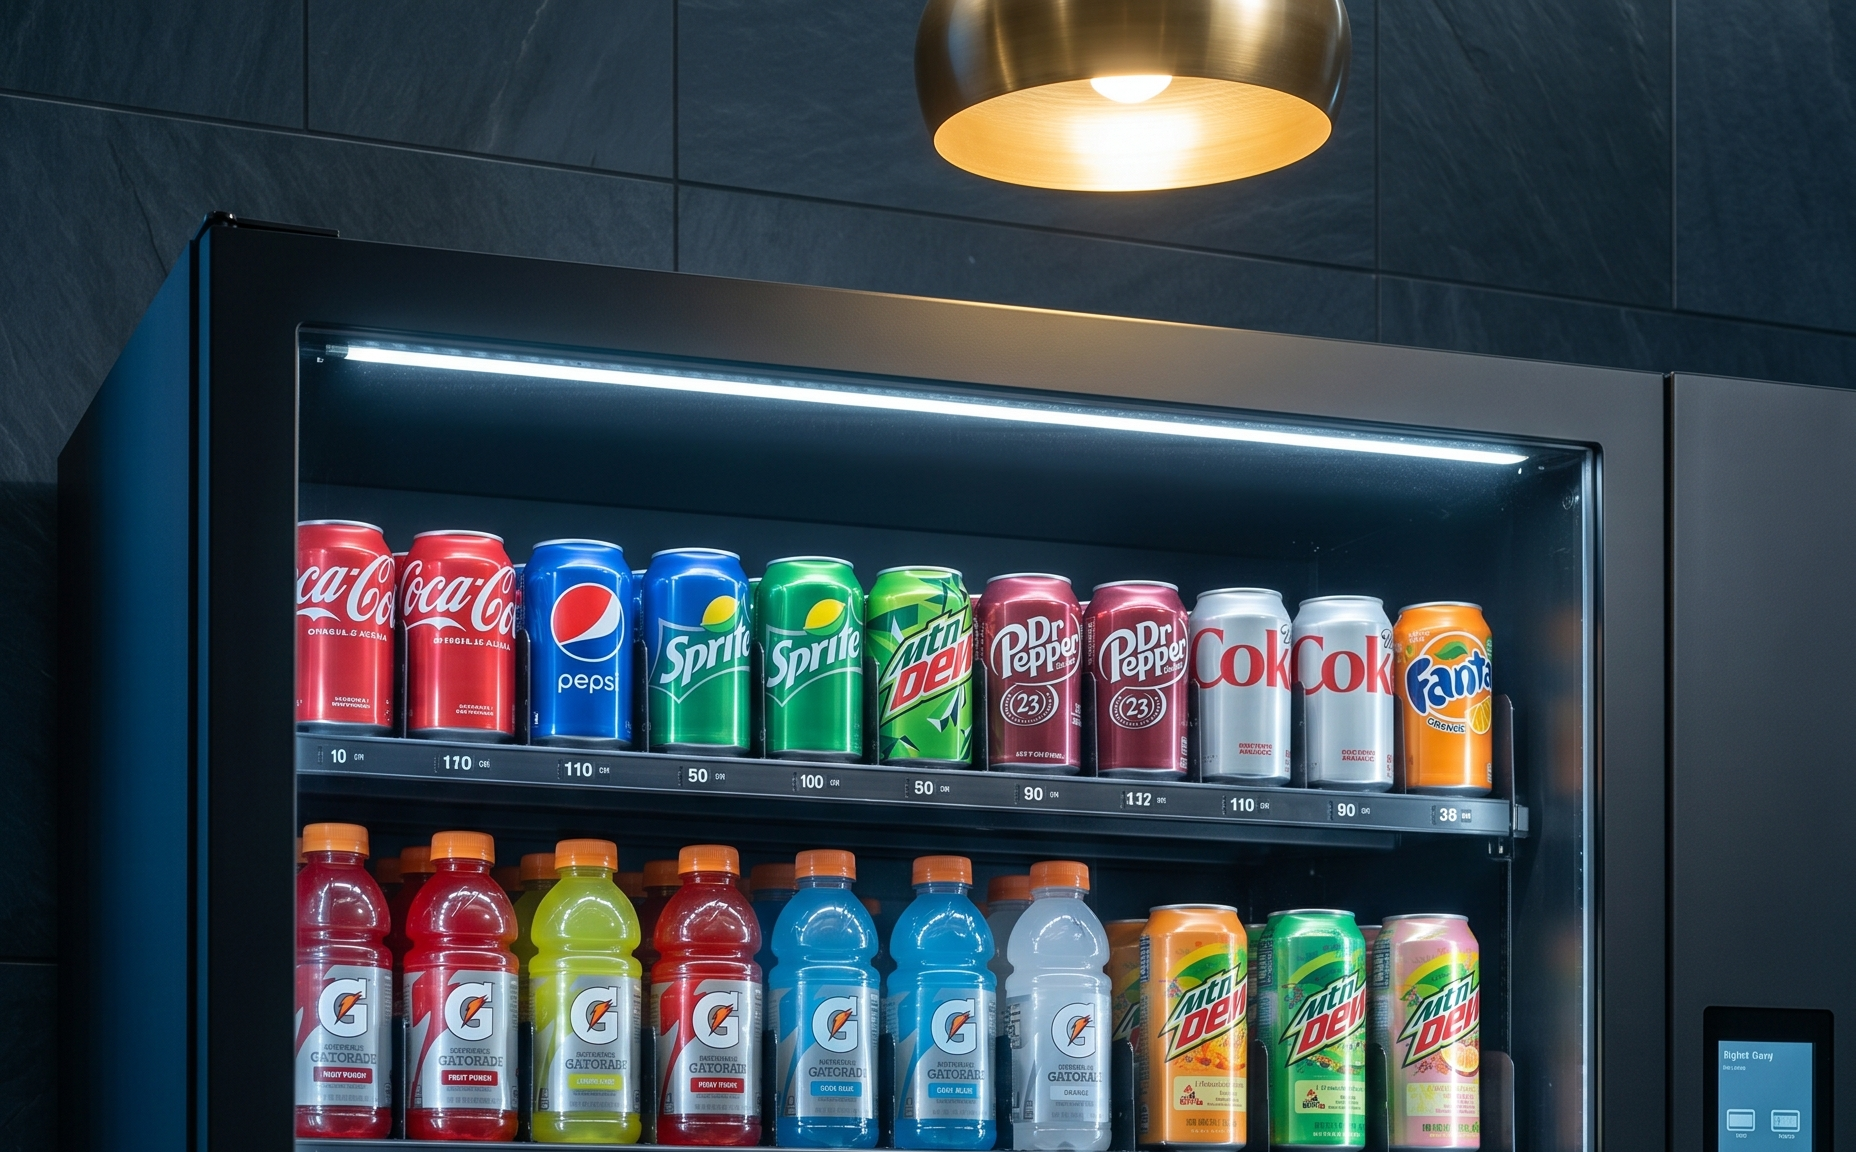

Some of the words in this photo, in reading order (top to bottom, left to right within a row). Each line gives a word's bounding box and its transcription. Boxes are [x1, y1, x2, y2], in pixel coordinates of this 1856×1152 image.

[660, 614, 750, 687] Sprite
[766, 618, 860, 690] Sprite
[889, 618, 961, 677] Mtn
[1000, 624, 1079, 680] Pepper
[1027, 616, 1064, 648] Dr
[1109, 628, 1186, 684] Pepper
[1136, 621, 1172, 652] Dr
[558, 672, 619, 693] pepsi
[1189, 627, 1292, 690] Cok
[1291, 635, 1394, 695] Cok
[1405, 648, 1491, 716] Fanta
[1017, 693, 1040, 714] 23
[1126, 697, 1149, 719] 23
[330, 748, 347, 764] 10
[564, 761, 593, 777] 110
[688, 768, 708, 783] 50
[800, 774, 824, 789] 100
[914, 780, 934, 795] 50
[1024, 786, 1044, 801] 90
[1230, 797, 1255, 812] 110
[1337, 802, 1356, 817] 90
[1439, 807, 1458, 822] 38
[318, 978, 368, 1038] G
[444, 982, 493, 1042] G
[569, 986, 618, 1045] G
[692, 990, 740, 1049] G
[1175, 974, 1232, 1020] Mtn
[1295, 978, 1354, 1027] Mtn
[1412, 981, 1470, 1029] Mtn
[812, 996, 859, 1053] G
[930, 998, 977, 1055] G
[1050, 1002, 1097, 1058] G
